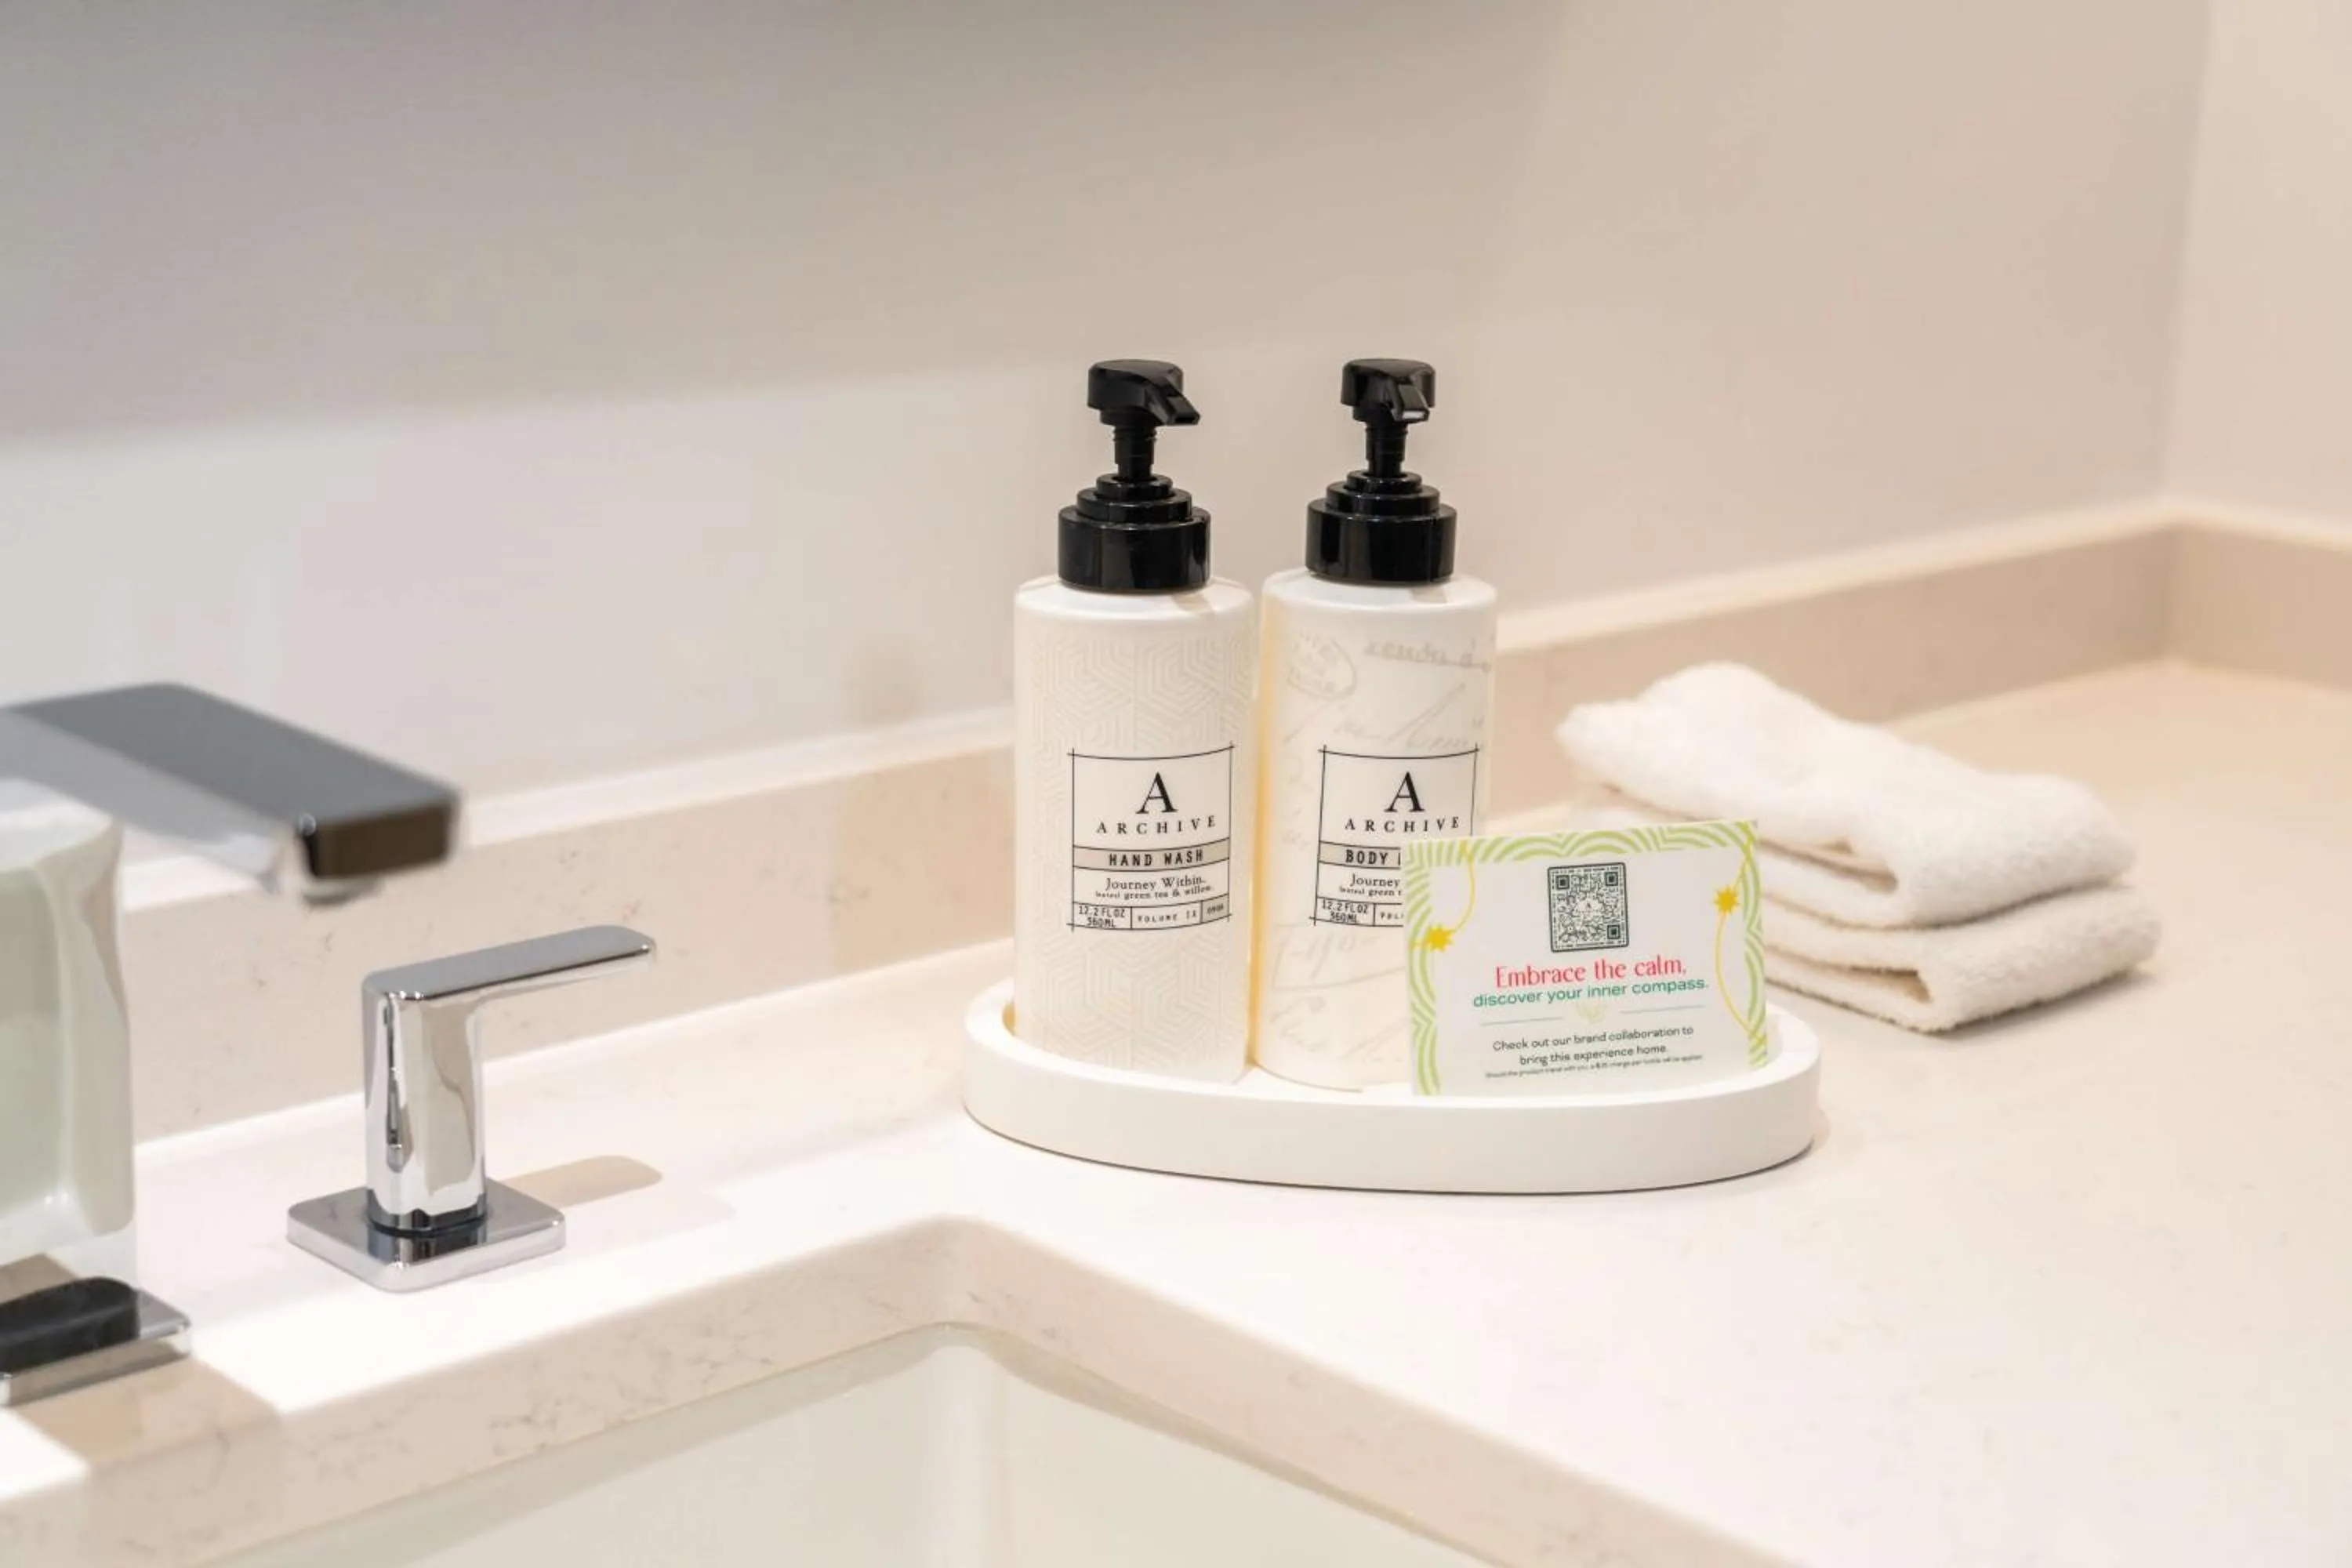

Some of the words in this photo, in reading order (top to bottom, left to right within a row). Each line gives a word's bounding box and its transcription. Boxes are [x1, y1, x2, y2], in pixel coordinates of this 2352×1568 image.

[1135, 771, 1178, 815] A
[1385, 771, 1425, 813] A
[1096, 815, 1216, 835] ARCHIVE
[1345, 816, 1460, 833] ARCHIVE
[1109, 854, 1152, 866] HAND
[1163, 849, 1204, 866] WASH
[1345, 849, 1388, 865] BODY
[1105, 877, 1156, 891] Journey
[1349, 873, 1401, 887] Journey
[1123, 892, 1151, 901] green
[1495, 964, 1587, 989] Embrace
[1594, 958, 1628, 980] the
[1634, 955, 1687, 977] calm,
[1473, 990, 1542, 1007] discover
[1548, 988, 1583, 1004] your
[1587, 984, 1628, 999] inner
[1632, 978, 1708, 996] compass.
[1493, 1038, 1527, 1051] Check
[1530, 1037, 1550, 1048] out
[1552, 1036, 1572, 1047] our
[1573, 1030, 1606, 1044] brand
[1608, 1026, 1679, 1042] collaboration
[1682, 1025, 1694, 1036] to
[1519, 1054, 1548, 1067] bring
[1550, 1051, 1570, 1062] this
[1573, 1047, 1634, 1062] experience
